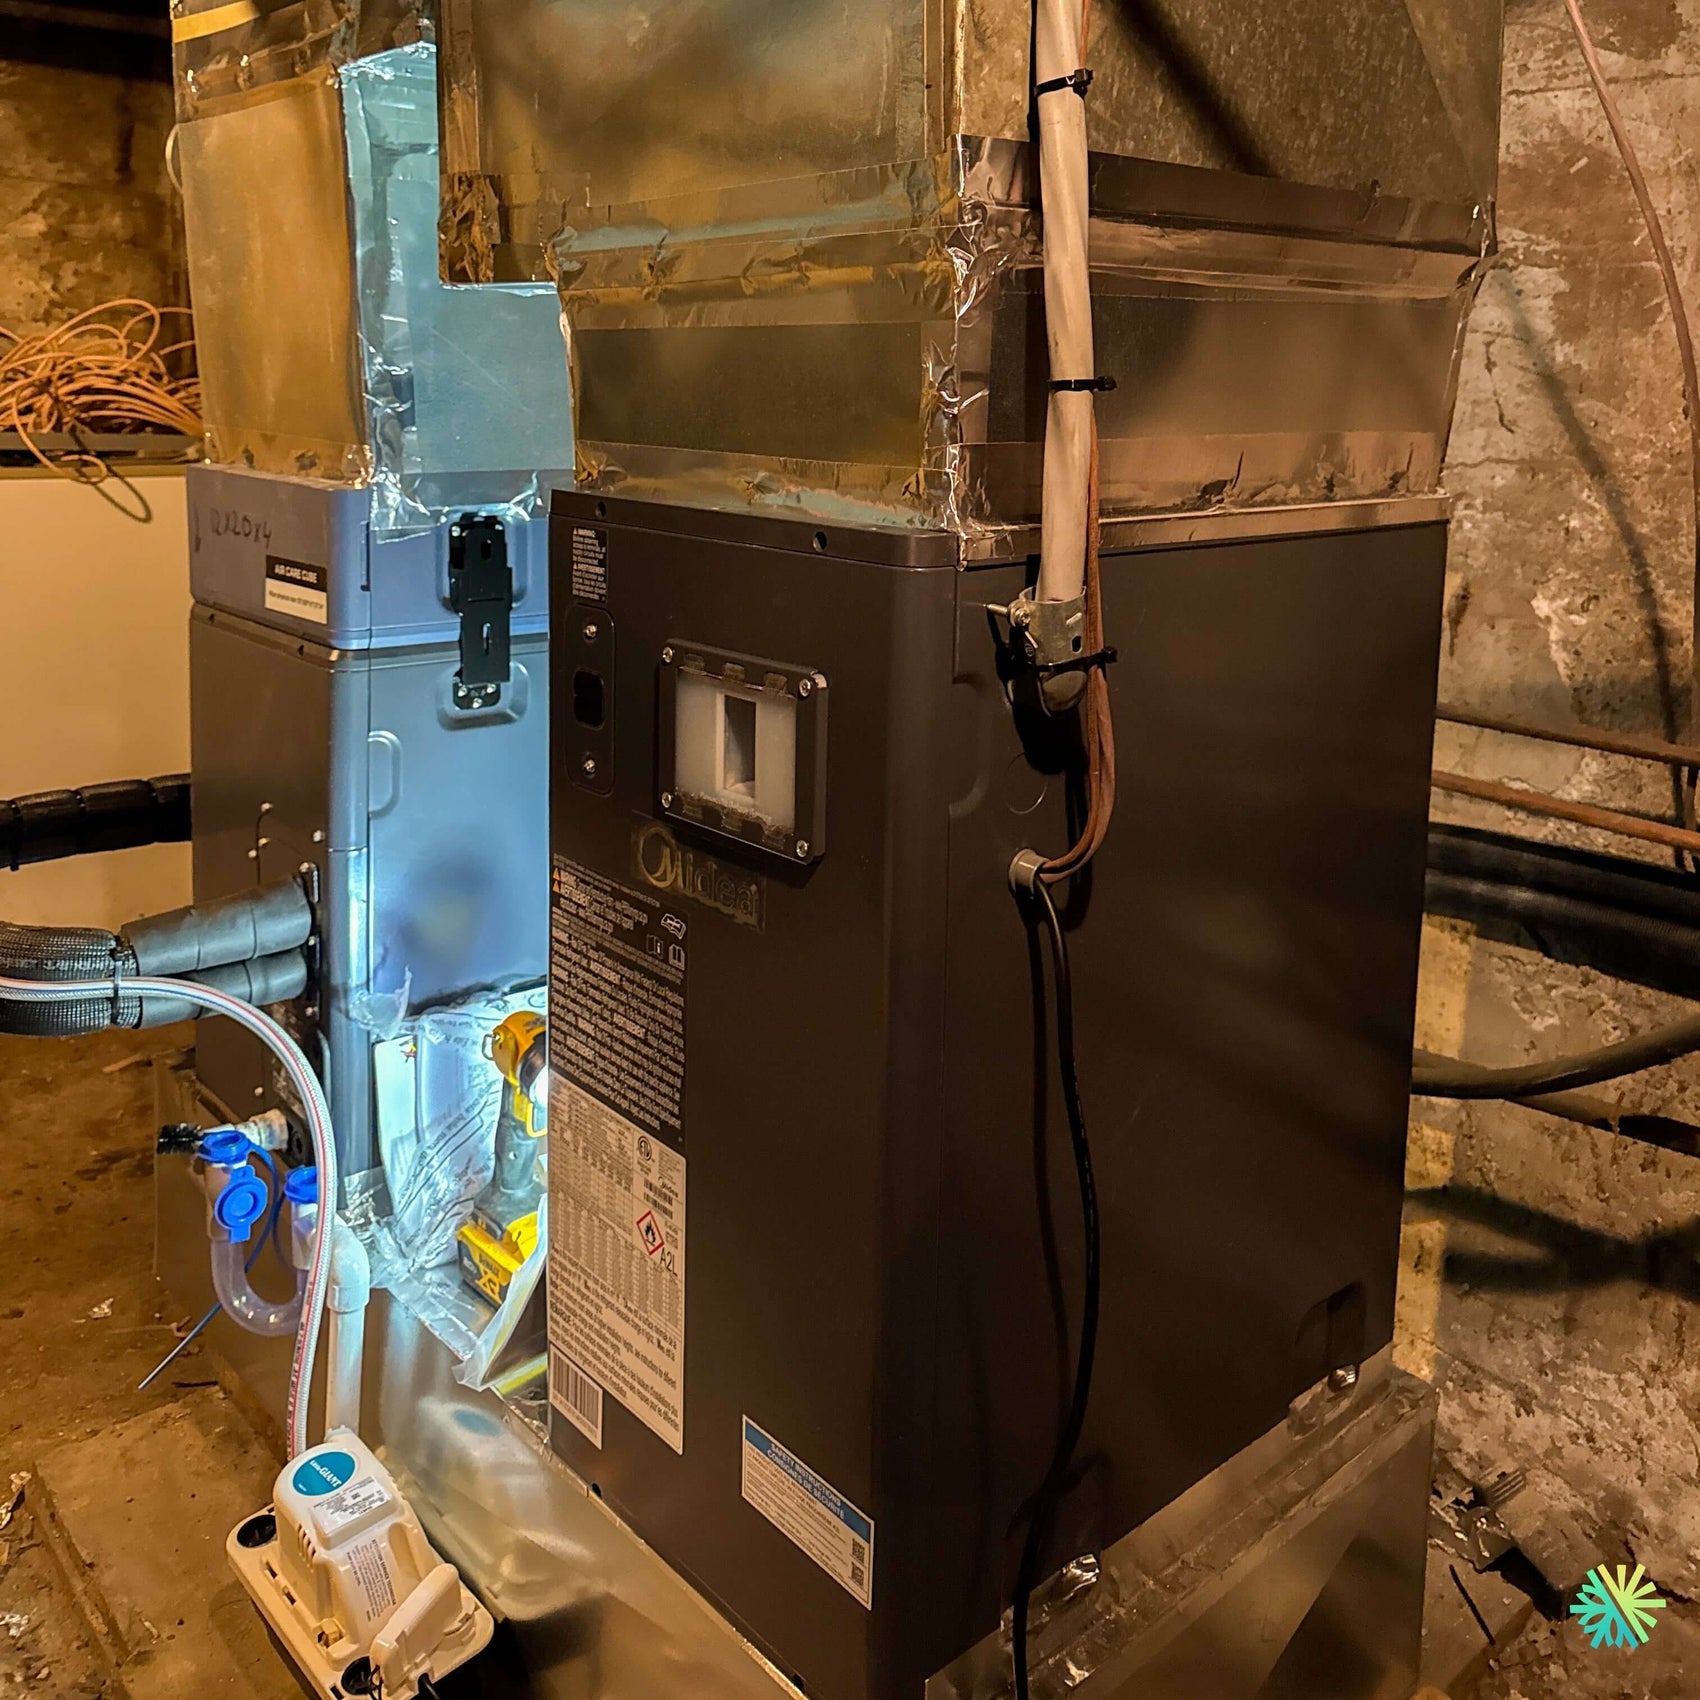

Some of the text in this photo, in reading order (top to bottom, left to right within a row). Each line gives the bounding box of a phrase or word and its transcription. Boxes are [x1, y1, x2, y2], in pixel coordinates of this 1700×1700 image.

[285, 566, 301, 579] CARE
[301, 570, 318, 584] CUBE
[660, 1247, 679, 1277] A2L
[318, 1466, 342, 1488] GIANT
[770, 1442, 840, 1508] SAFETY INSTRUCTIONS
